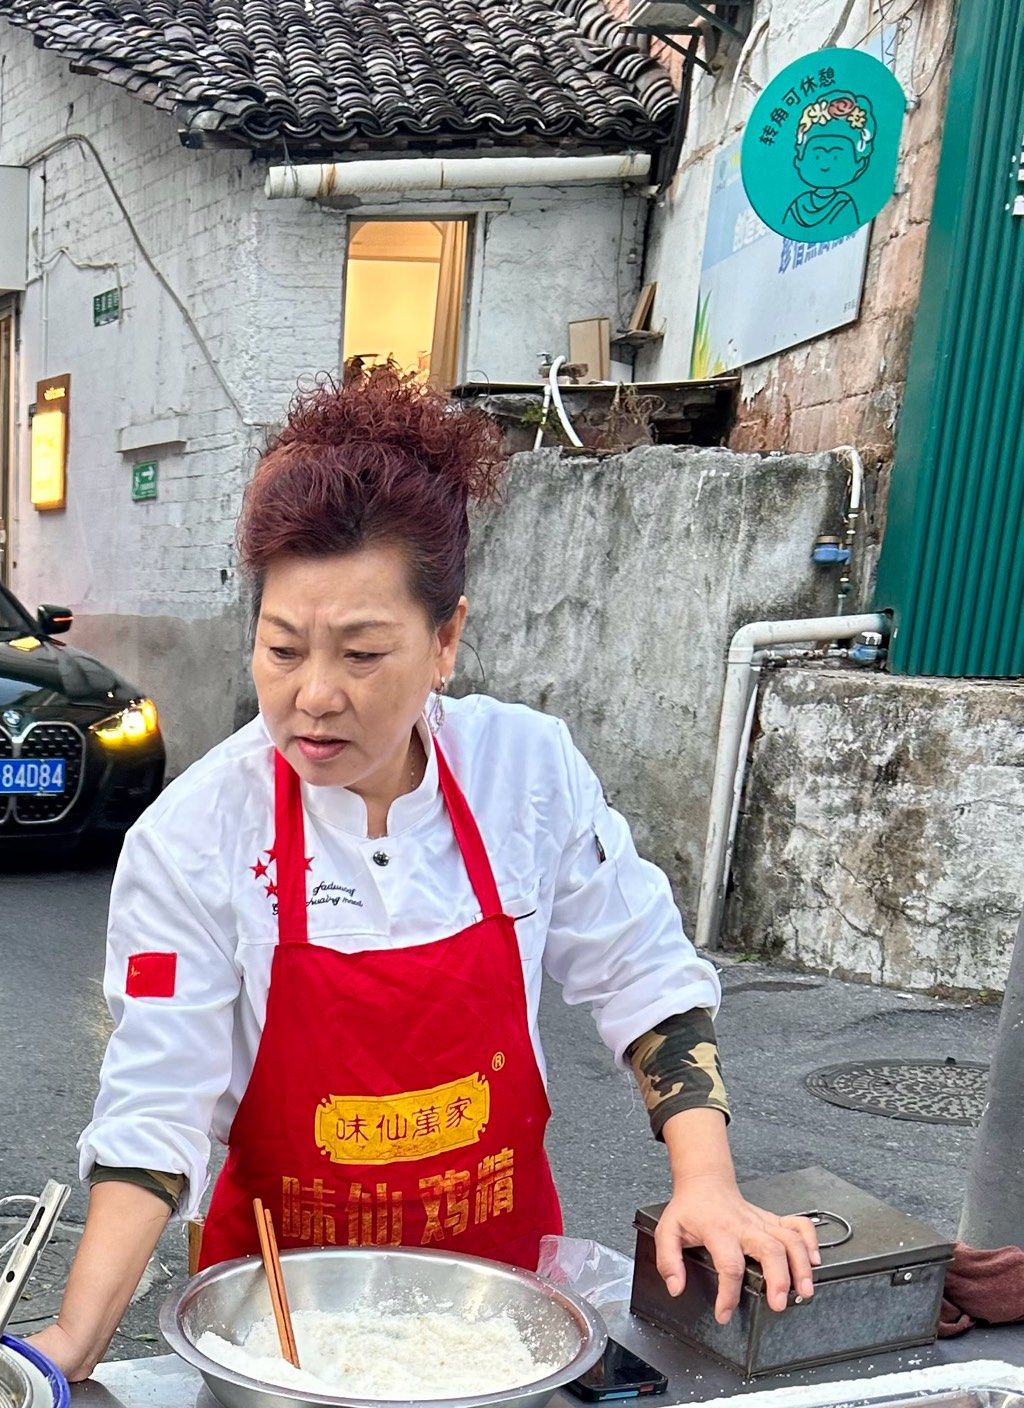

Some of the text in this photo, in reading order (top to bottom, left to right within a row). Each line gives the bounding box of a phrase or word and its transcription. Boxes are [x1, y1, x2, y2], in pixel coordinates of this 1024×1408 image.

[759, 66, 836, 147] 转角可休憩
[335, 1096, 474, 1143] 味仙萬家
[281, 1147, 515, 1248] 味仙鸡精
